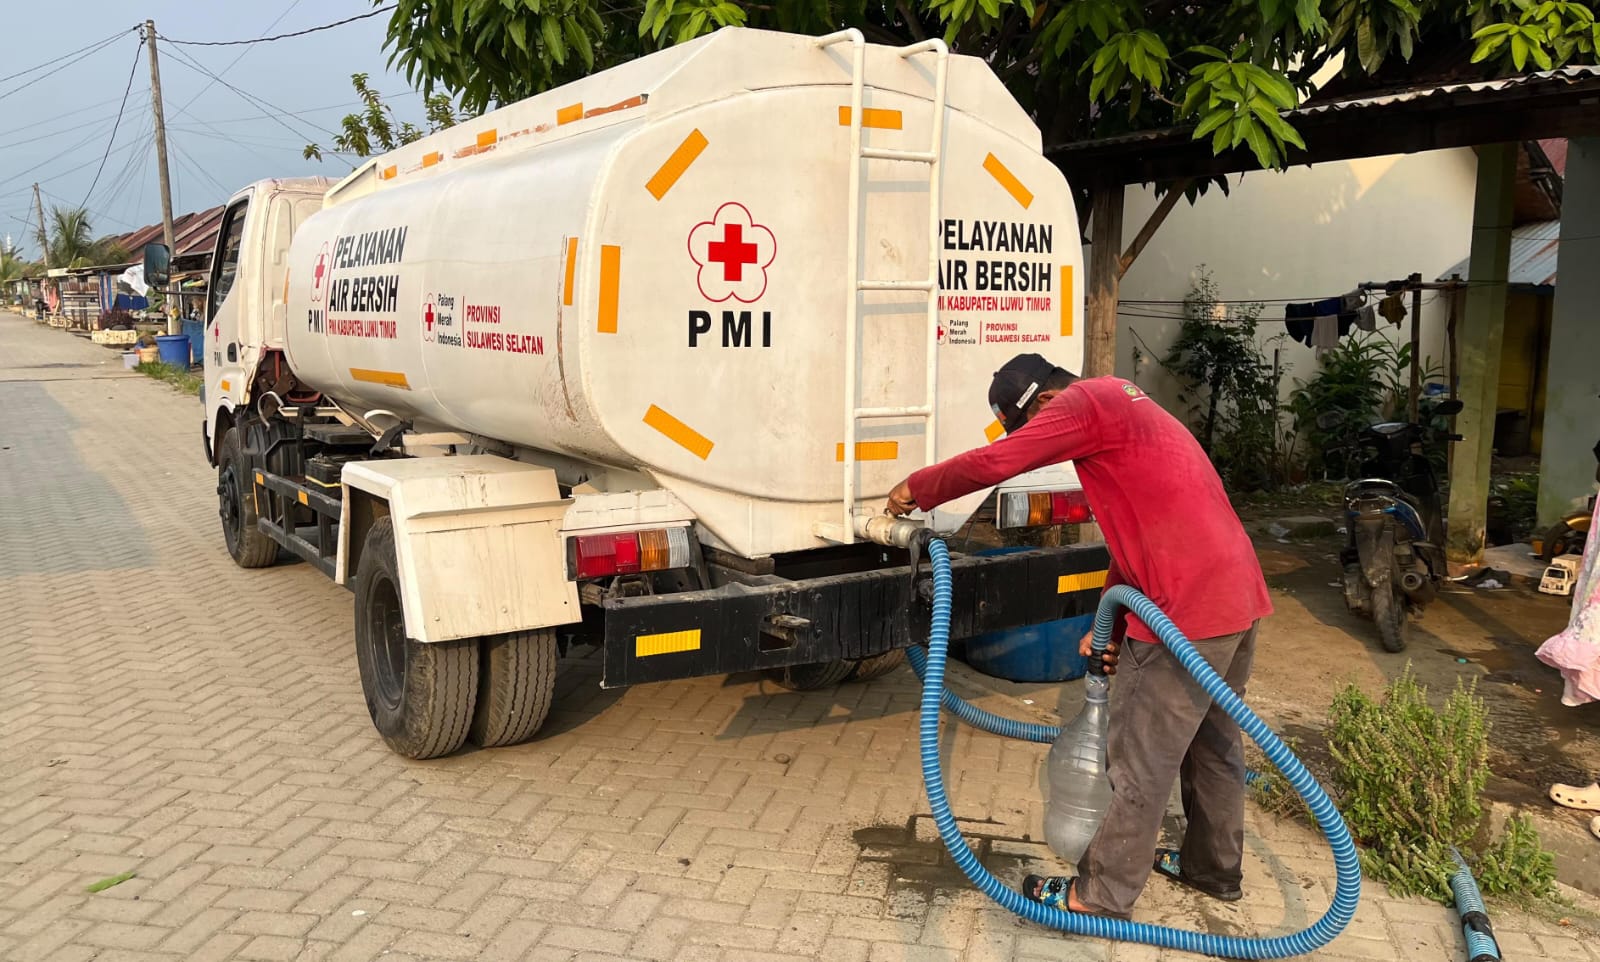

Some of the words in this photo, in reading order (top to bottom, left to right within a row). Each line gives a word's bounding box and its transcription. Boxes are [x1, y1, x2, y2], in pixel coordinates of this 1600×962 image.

[939, 219, 1052, 254] ELAYANAN
[333, 225, 408, 269] PELAYANAN
[975, 260, 1052, 292] BERSIH
[329, 279, 350, 312] AIR
[350, 275, 399, 313] BERSIH
[437, 293, 455, 310] Palang
[947, 295, 998, 311] KABUPATEN
[1000, 297, 1024, 311] LUWU
[1026, 297, 1051, 312] TIMUR
[308, 309, 324, 334] PMI
[437, 312, 452, 326] Merah
[466, 305, 501, 324] PROVINSI
[949, 319, 969, 328] Palang
[337, 319, 364, 336] KABUPATEN
[379, 320, 397, 339] TIMUR
[688, 310, 771, 347] PMI
[949, 328, 967, 336] Merah
[985, 323, 1018, 331] PROVINSI
[437, 331, 462, 347] Indonesia
[466, 331, 504, 351] SULAWESI
[505, 333, 544, 355] SELATAN
[949, 337, 976, 345] Indonesia
[985, 334, 1020, 343] SULAWESI
[1021, 334, 1051, 343] SELATAN
